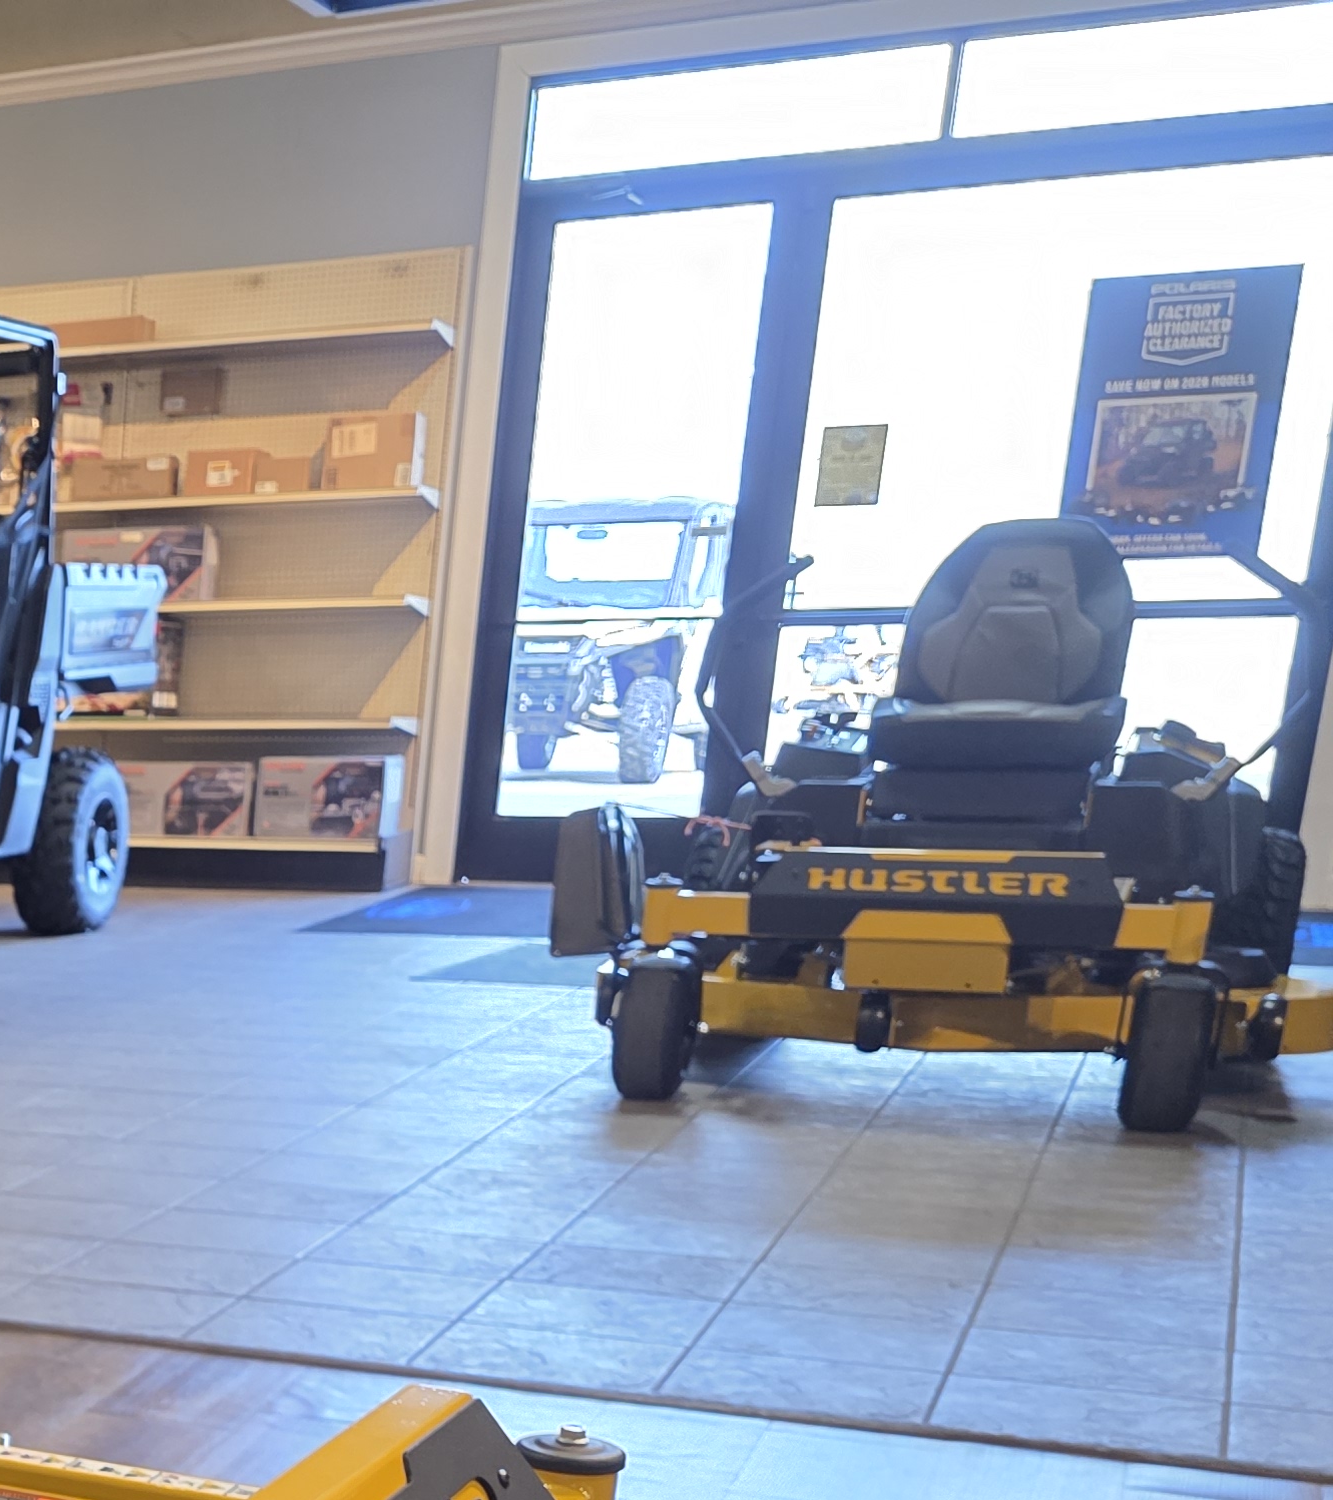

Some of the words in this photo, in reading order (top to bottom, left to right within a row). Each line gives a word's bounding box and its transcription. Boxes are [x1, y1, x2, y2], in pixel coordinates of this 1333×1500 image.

[1158, 302, 1222, 320] FACTORY
[1144, 318, 1232, 337] AUTHORIZED
[1148, 334, 1221, 352] CLEARANCE
[1104, 380, 1134, 394] SAVE
[1134, 378, 1161, 391] NOW
[1211, 373, 1256, 387] MODELS
[806, 866, 1070, 897] HUSTLER
